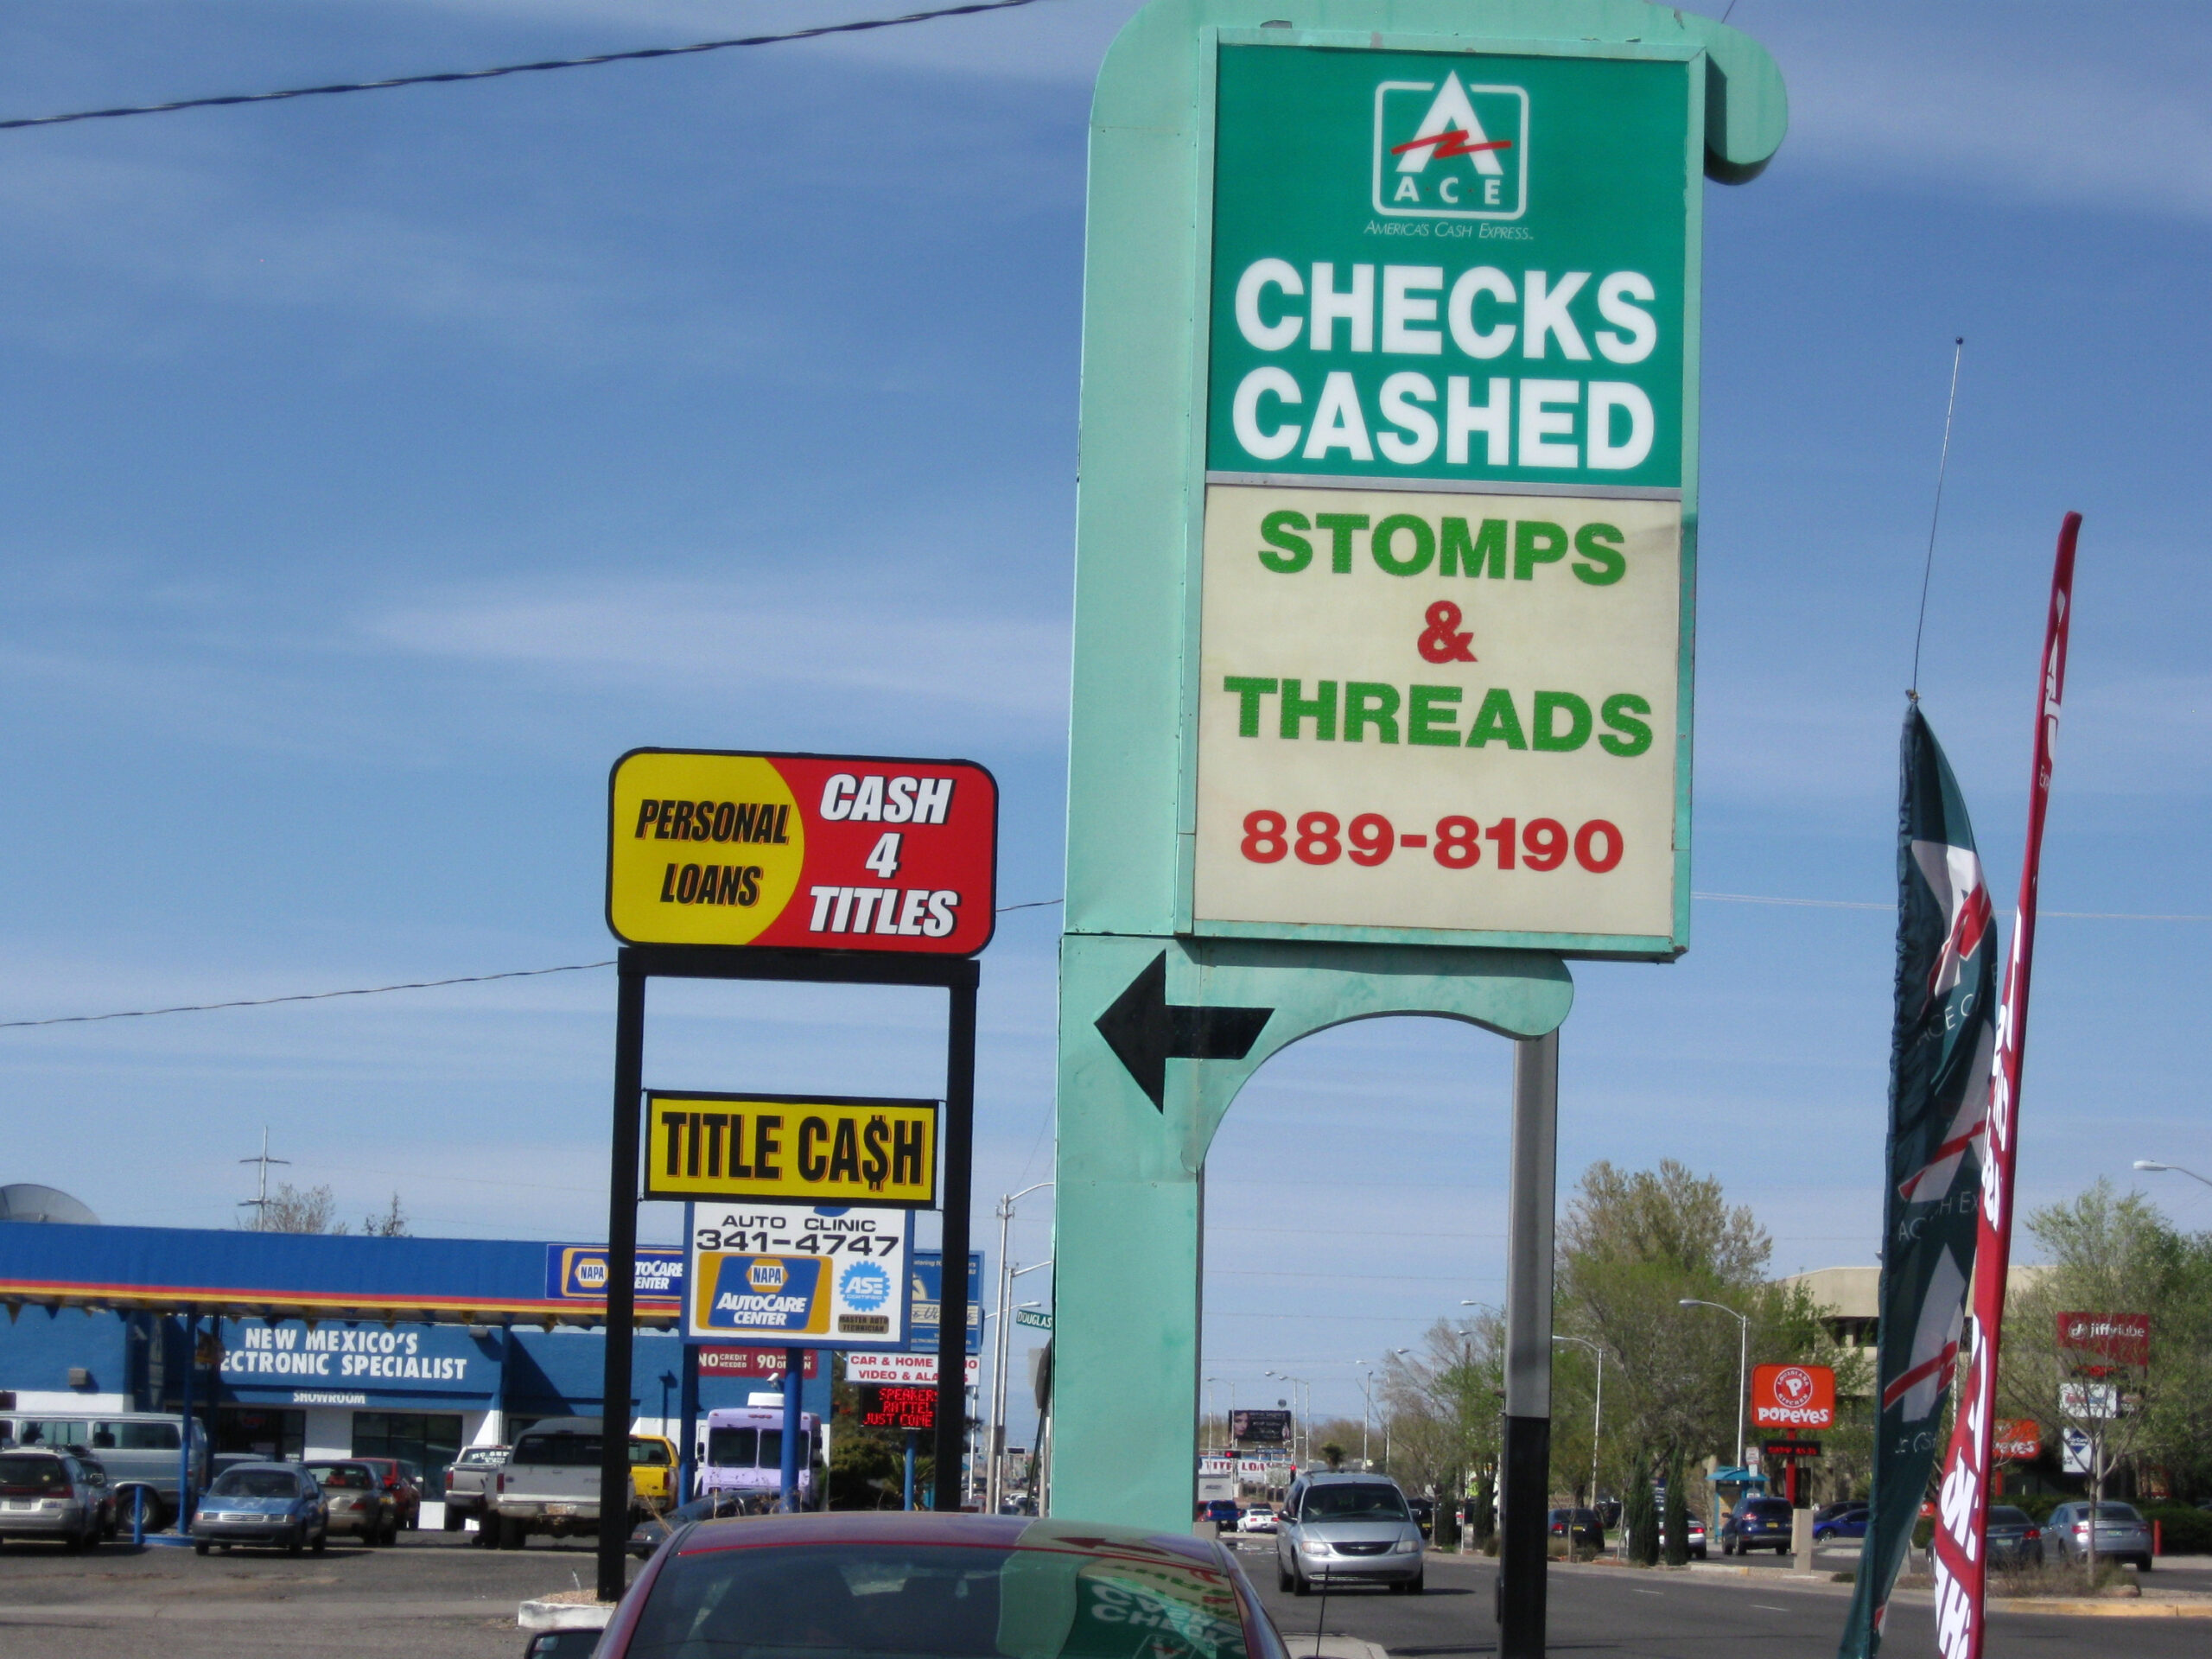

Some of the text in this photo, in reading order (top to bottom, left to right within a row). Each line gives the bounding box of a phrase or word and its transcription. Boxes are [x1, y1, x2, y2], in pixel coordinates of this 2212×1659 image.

[1363, 219, 1529, 240] AMERICA'S CASH EXPRESS
[1235, 257, 1657, 365] CHECKS
[1232, 365, 1655, 470] CASHED
[1257, 510, 1626, 586] STOMPS
[1417, 600, 1478, 664] &
[1224, 676, 1653, 757] THREADS
[819, 773, 956, 825] CASH
[634, 799, 791, 846] PERSONAL
[1240, 810, 1624, 874] 889-8190
[865, 832, 904, 880] 4
[659, 862, 763, 908] LOANS
[809, 886, 960, 938] TITLES
[661, 1111, 926, 1192] TITLE CA$H
[721, 1215, 876, 1232] AUTO CLINIC
[696, 1229, 899, 1256] 341-4747
[581, 1266, 604, 1280] NAPA
[635, 1260, 683, 1277] TOCARE
[753, 1267, 782, 1284] NAPA
[634, 1277, 670, 1289] ENTER
[844, 1276, 884, 1295] ASE
[716, 1292, 807, 1313] AUTOCARE
[734, 1312, 787, 1326] CENTER
[1018, 1312, 1052, 1328] DOUGLAS
[245, 1328, 418, 1355] NEW MEXICO'S
[195, 1351, 467, 1380] ECTRONIC SPECIALIST
[698, 1353, 719, 1367] NO
[757, 1354, 775, 1369] 90
[850, 1356, 933, 1367] CAR & HOME
[859, 1370, 897, 1380] VIDEO
[901, 1371, 912, 1381] &
[293, 1391, 366, 1404] SHOWROOM
[862, 1413, 933, 1427] JUST COME
[1758, 1407, 1829, 1424] POPEYES
